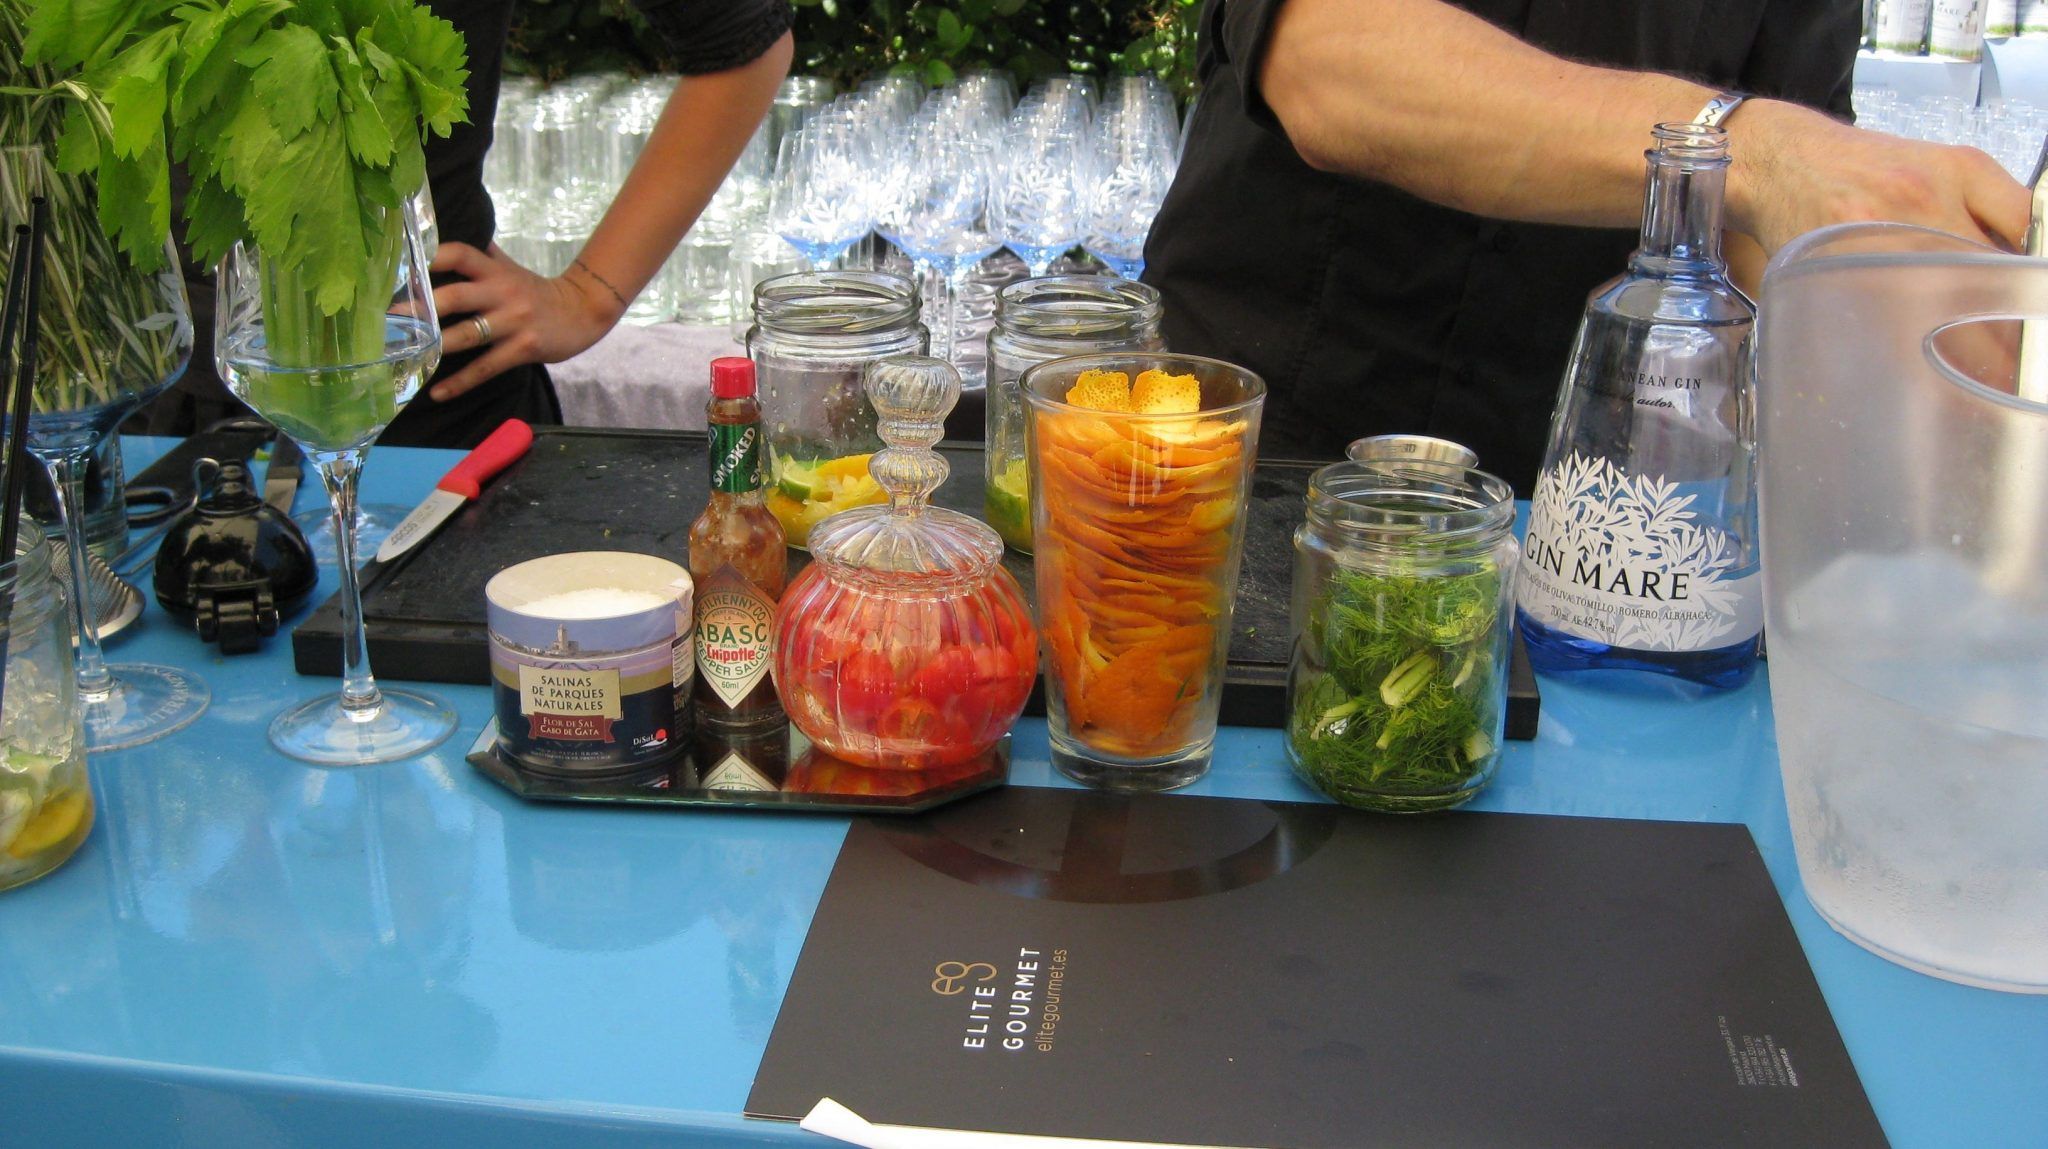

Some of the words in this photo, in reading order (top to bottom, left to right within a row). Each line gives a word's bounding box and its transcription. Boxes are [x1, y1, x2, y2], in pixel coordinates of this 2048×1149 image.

[1675, 377, 1702, 390] GIN
[713, 427, 756, 487] SMOKED
[1526, 531, 1566, 577] GIN
[1571, 557, 1690, 601] MARE
[695, 622, 768, 645] ABASC
[735, 643, 768, 676] SAUCE
[532, 685, 544, 697] DE
[550, 688, 604, 700] PARQUES
[541, 675, 592, 687] SALINAS
[534, 698, 603, 711] NATURALES
[540, 725, 562, 735] CABO
[564, 728, 573, 736] DE
[575, 727, 600, 736] GATA
[543, 716, 564, 727] FLOR
[566, 719, 576, 728] DE
[578, 719, 594, 728] SAL
[1003, 947, 1040, 1050] GOURMET
[1034, 949, 1068, 1052] elitegourmet.es
[963, 986, 996, 1048] ELITE
